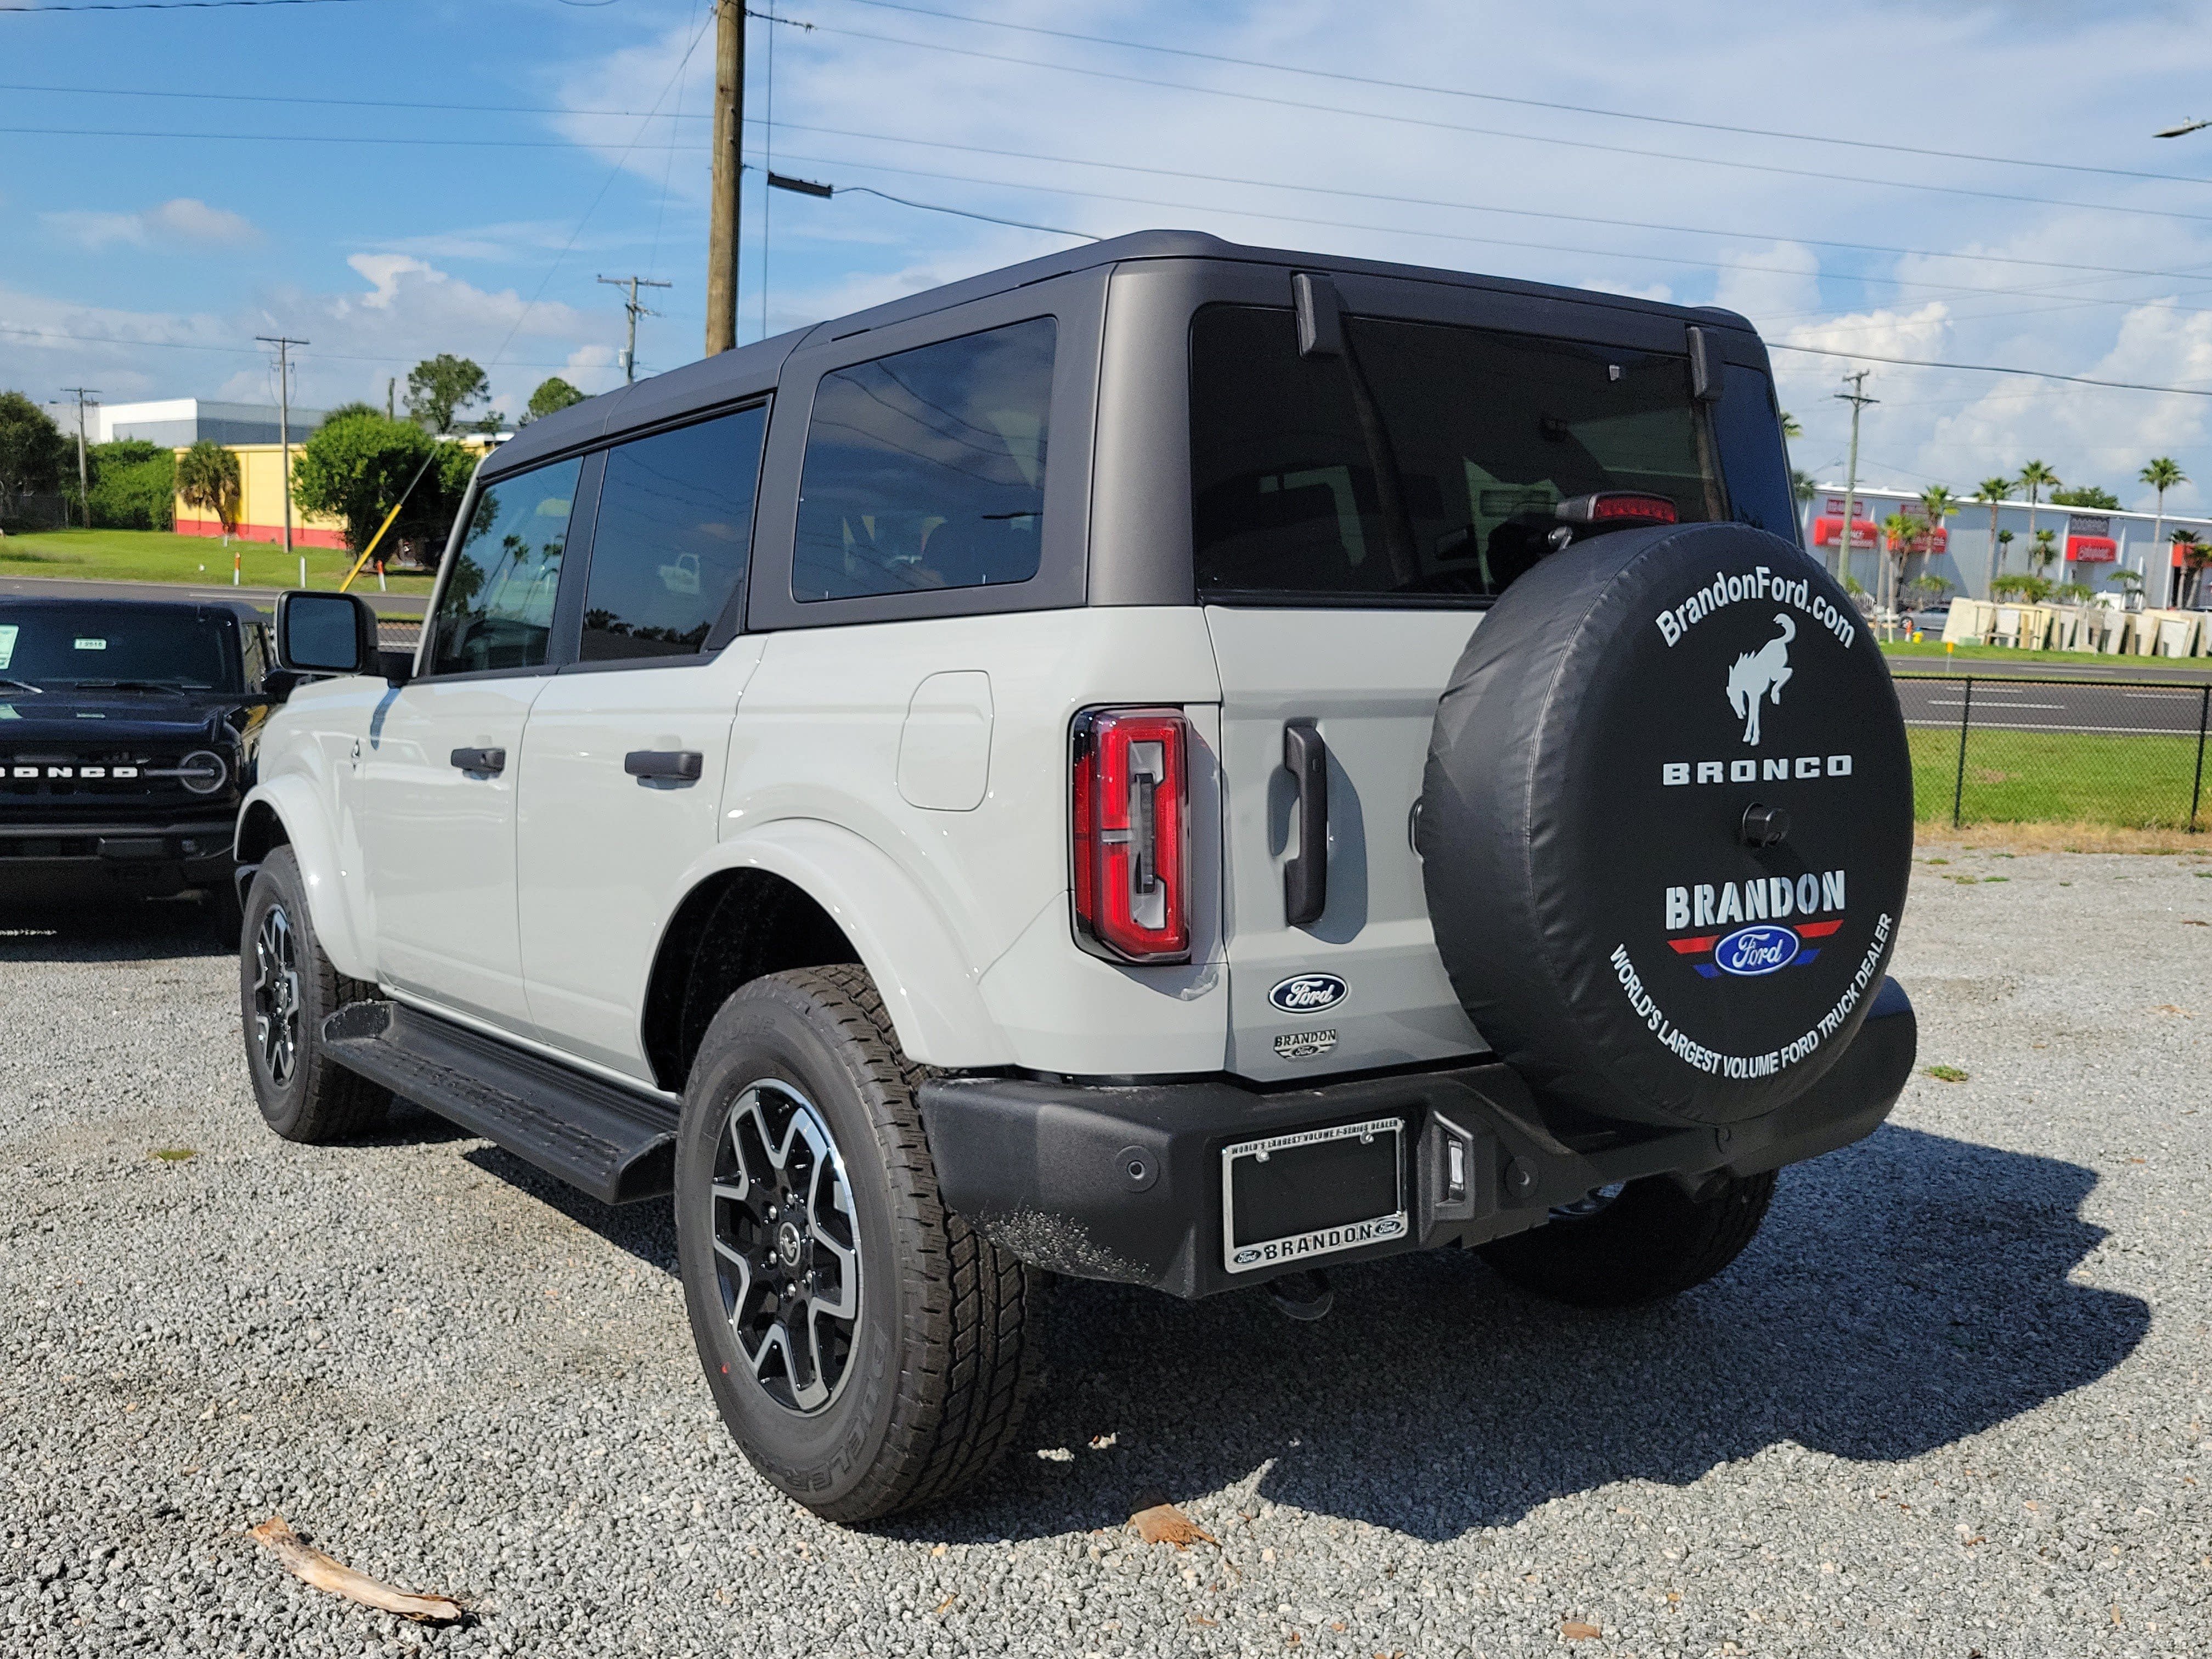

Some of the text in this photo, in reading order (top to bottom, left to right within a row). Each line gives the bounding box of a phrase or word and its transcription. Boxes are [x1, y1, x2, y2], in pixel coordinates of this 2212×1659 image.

[1656, 566, 1855, 648] BrandonFord.com
[0, 767, 138, 777] ONCO
[1663, 755, 1852, 785] BRONCO
[1666, 870, 1845, 929] BRANDON
[1731, 933, 1783, 969] Ford
[1285, 980, 1335, 1006] Ford
[1610, 913, 1892, 1079] WORLD'S LARGEST VOLUME FORD TRUCK DEALER
[1275, 1029, 1336, 1047] BRANDON
[1268, 1136, 1302, 1147] LARGEST
[1304, 1130, 1333, 1141] VOLUME
[1371, 1119, 1397, 1130] DEALER
[1237, 1220, 1398, 1263] Ford BRANDON Ford
